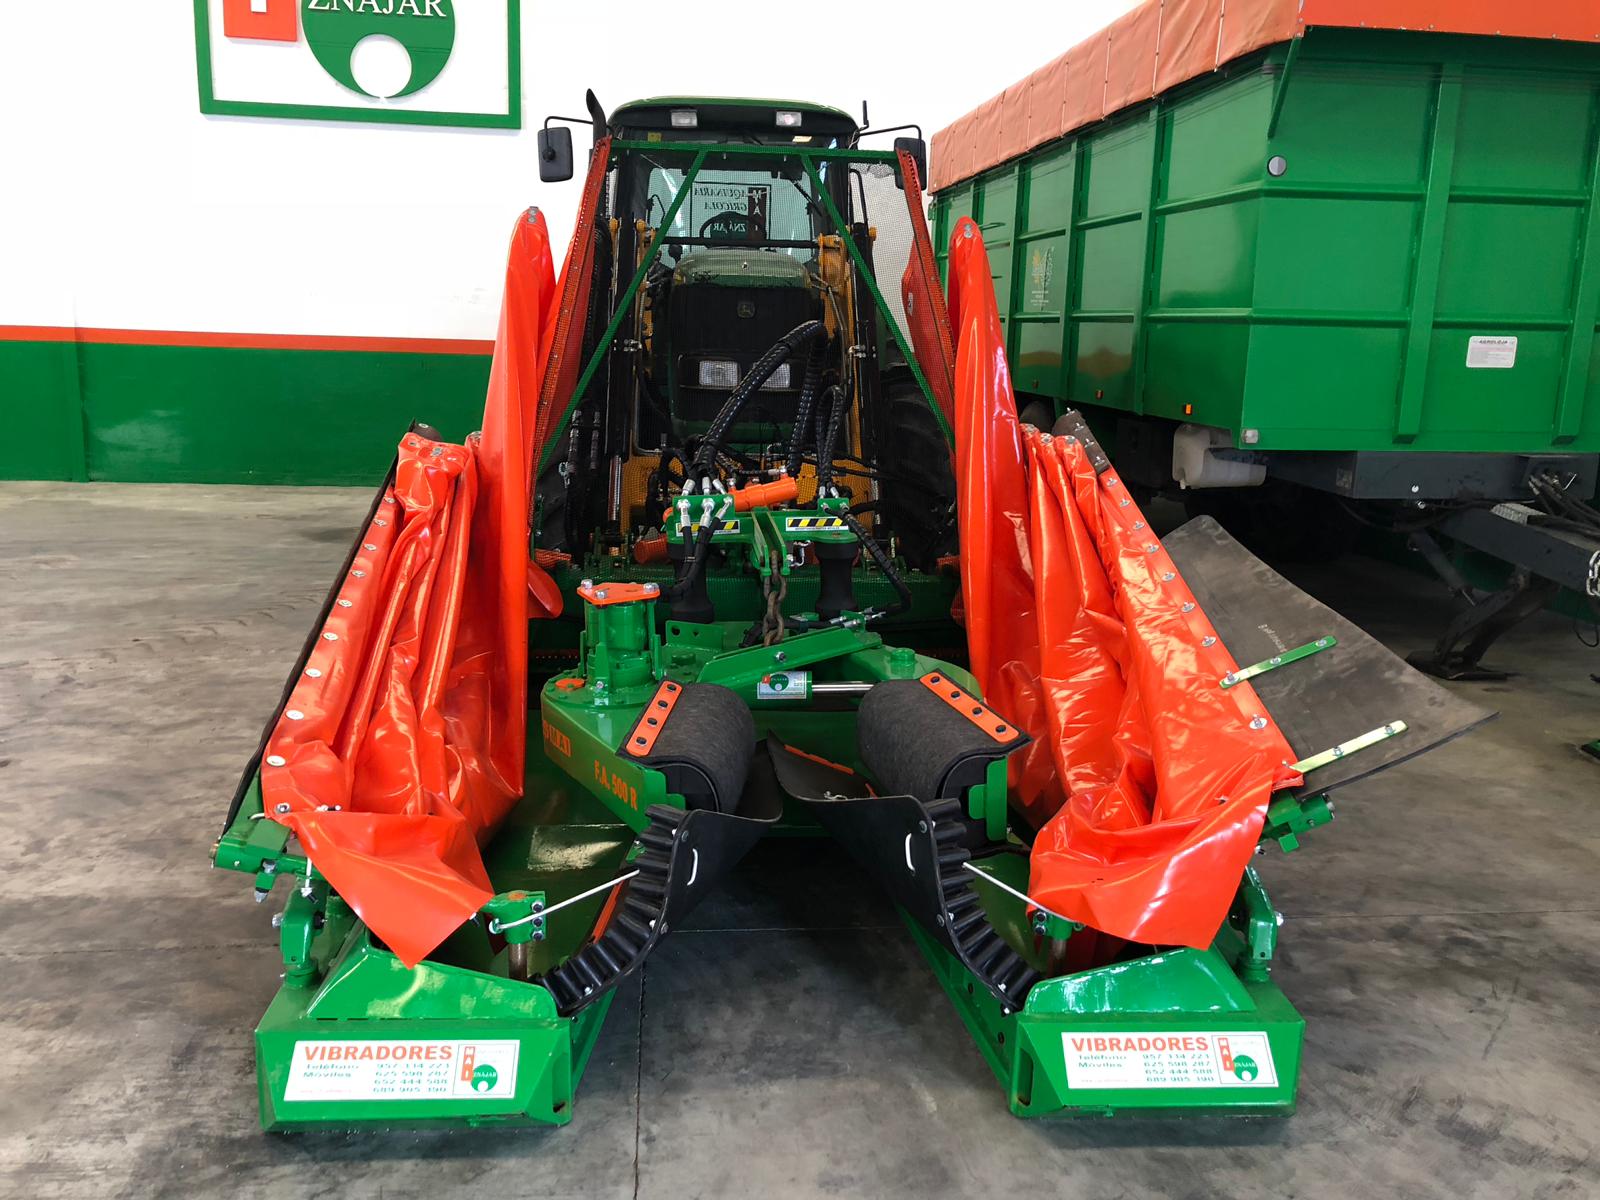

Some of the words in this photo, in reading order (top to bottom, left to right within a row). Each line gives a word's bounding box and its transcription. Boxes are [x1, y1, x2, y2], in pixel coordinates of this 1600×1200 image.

[611, 773, 629, 804] 500
[630, 786, 638, 811] R
[304, 1045, 453, 1061] VIBRADORES
[1071, 1036, 1209, 1052] VIBRADORES
[464, 1046, 475, 1080] MAI
